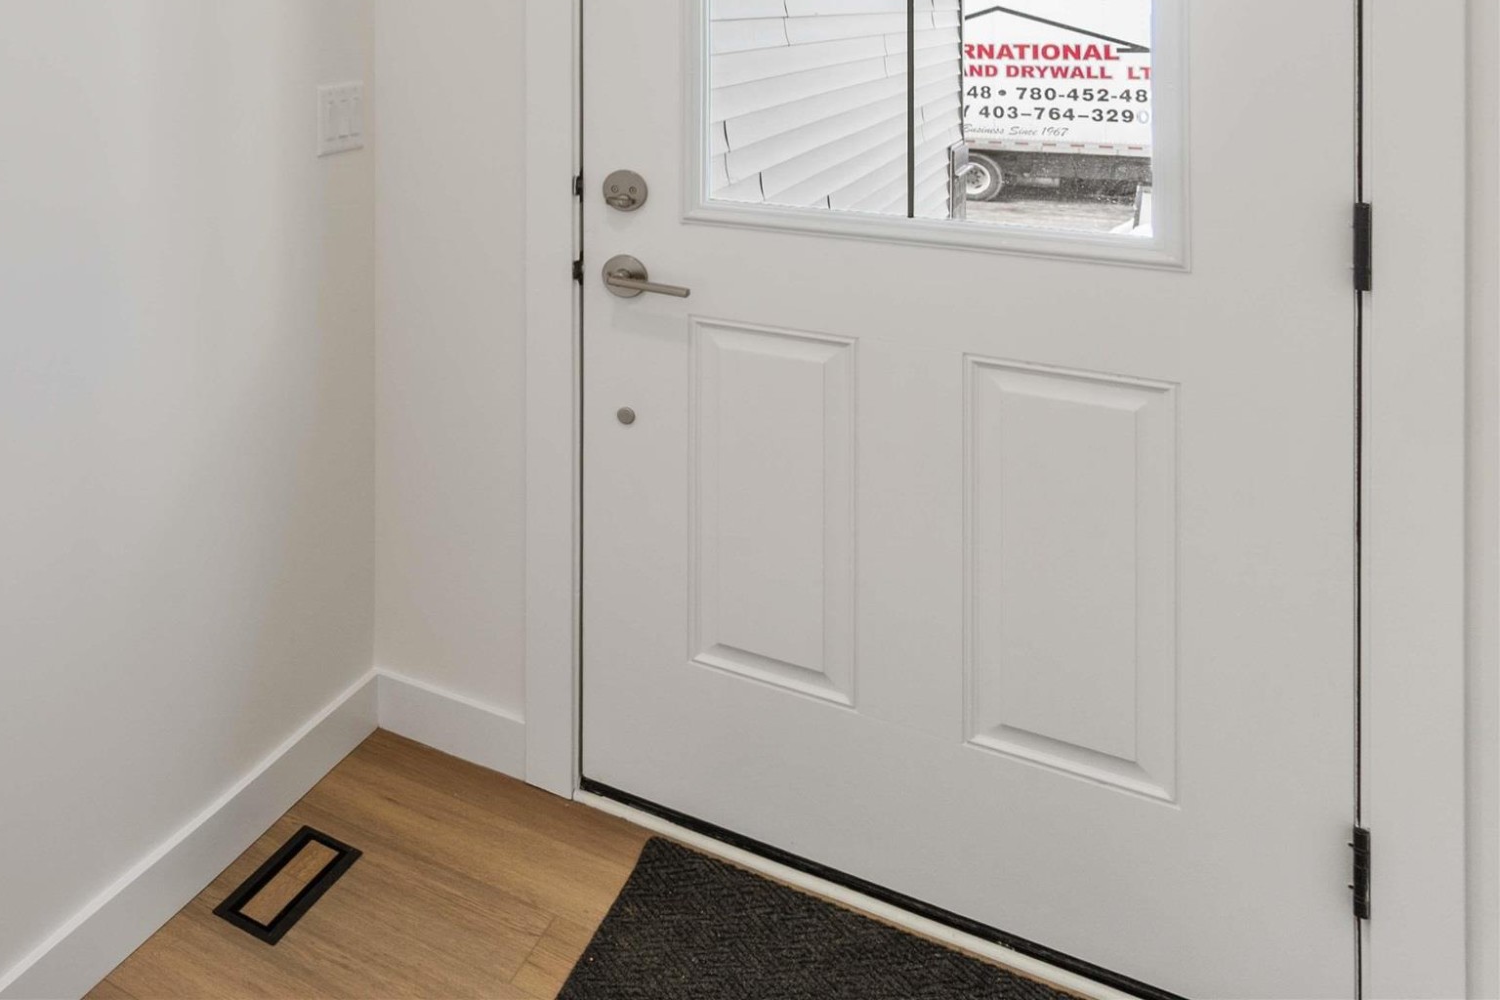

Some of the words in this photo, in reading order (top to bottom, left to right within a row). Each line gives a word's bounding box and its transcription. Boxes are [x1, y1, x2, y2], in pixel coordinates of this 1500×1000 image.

[1006, 65, 1113, 79] DRYWALL
[967, 86, 992, 99] 48
[1016, 87, 1148, 103] 780-452-48
[1008, 126, 1038, 136] Since
[1041, 126, 1069, 137] 1967
